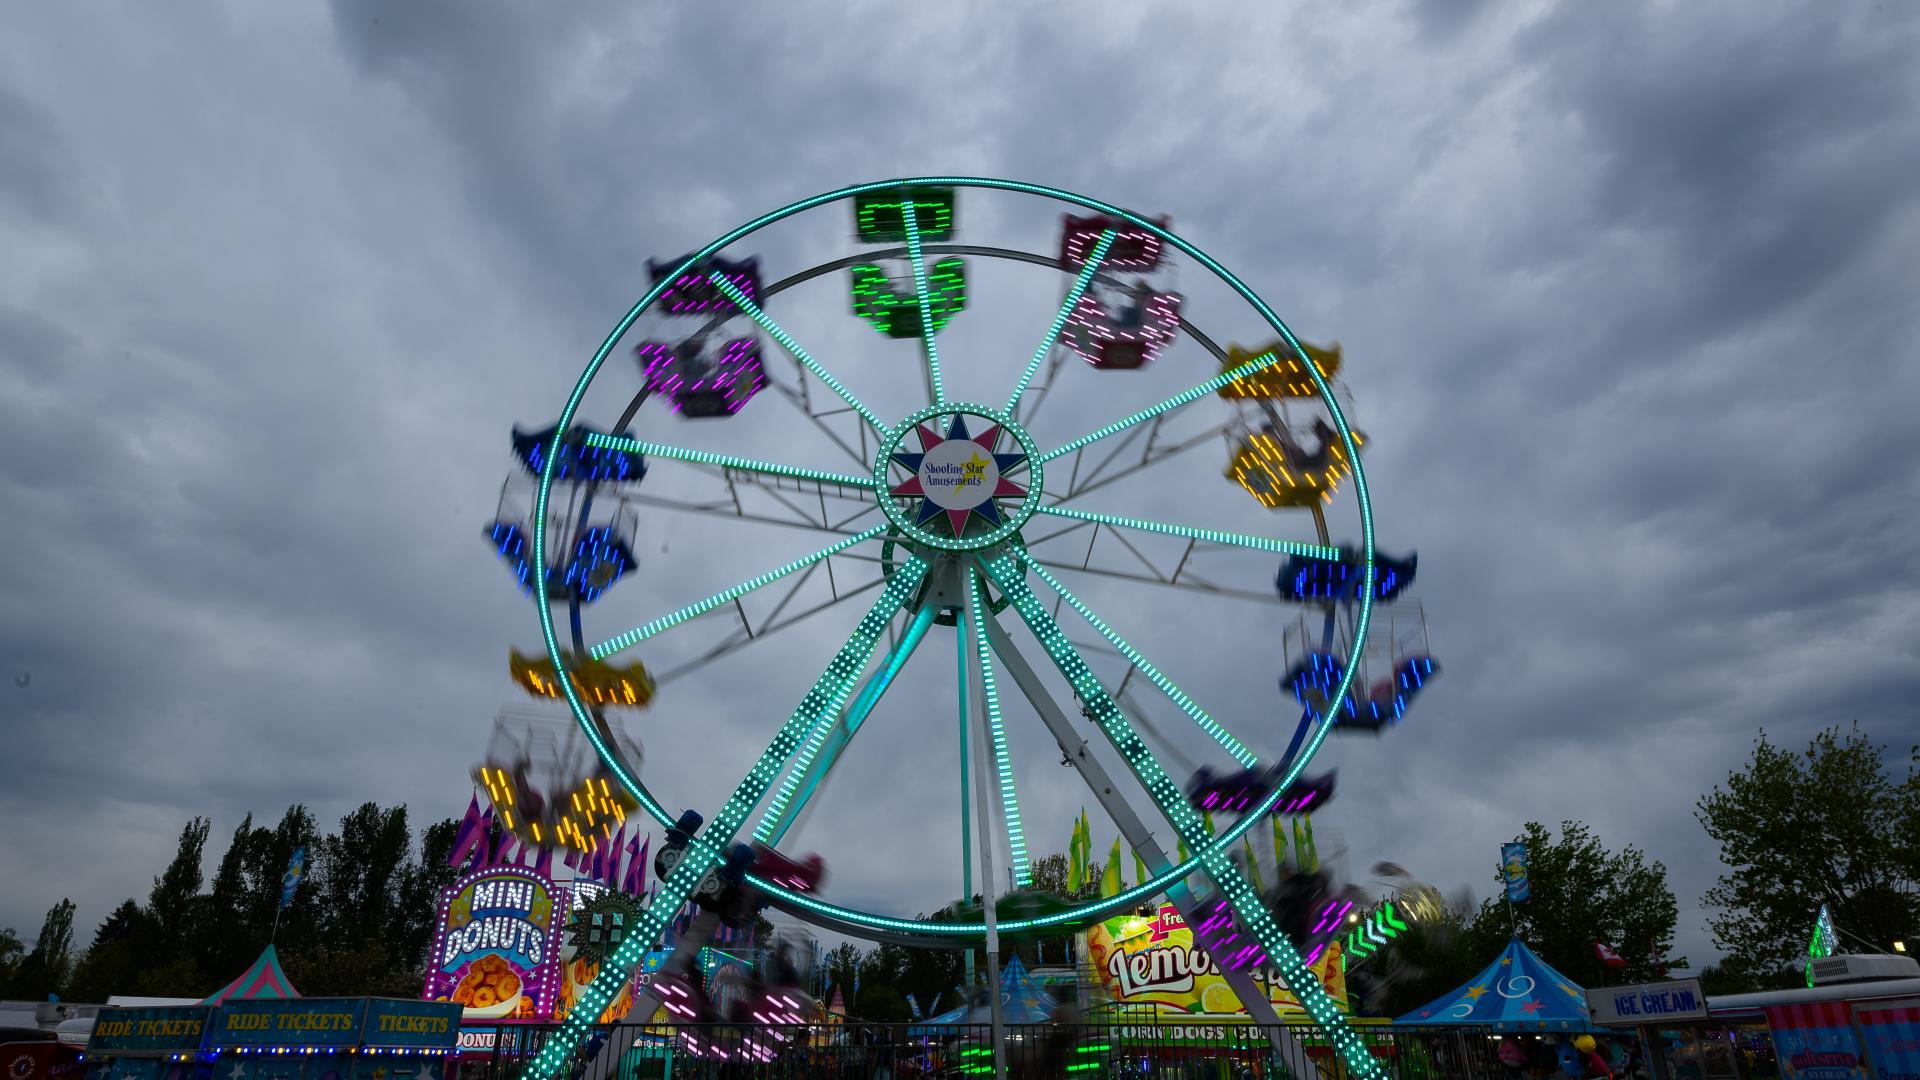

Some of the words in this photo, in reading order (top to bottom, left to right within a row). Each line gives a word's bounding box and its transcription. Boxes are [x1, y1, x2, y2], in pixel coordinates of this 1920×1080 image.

[925, 463, 963, 475] Shooting
[966, 462, 984, 474] Star
[925, 475, 982, 486] Amusements
[471, 881, 535, 912] MINI
[1162, 912, 1184, 926] Fre
[442, 915, 545, 966] DONUTS
[1614, 995, 1640, 1016] ICE
[1641, 990, 1697, 1014] CREAM
[96, 1020, 133, 1037] RIDE
[137, 1020, 202, 1036] TICKETS
[226, 1014, 272, 1030] RIDE
[277, 1014, 353, 1030] TICKETS
[379, 1015, 449, 1032] TICKETS
[1111, 1026, 1165, 1040] CORN
[1170, 1026, 1225, 1040] DOGS
